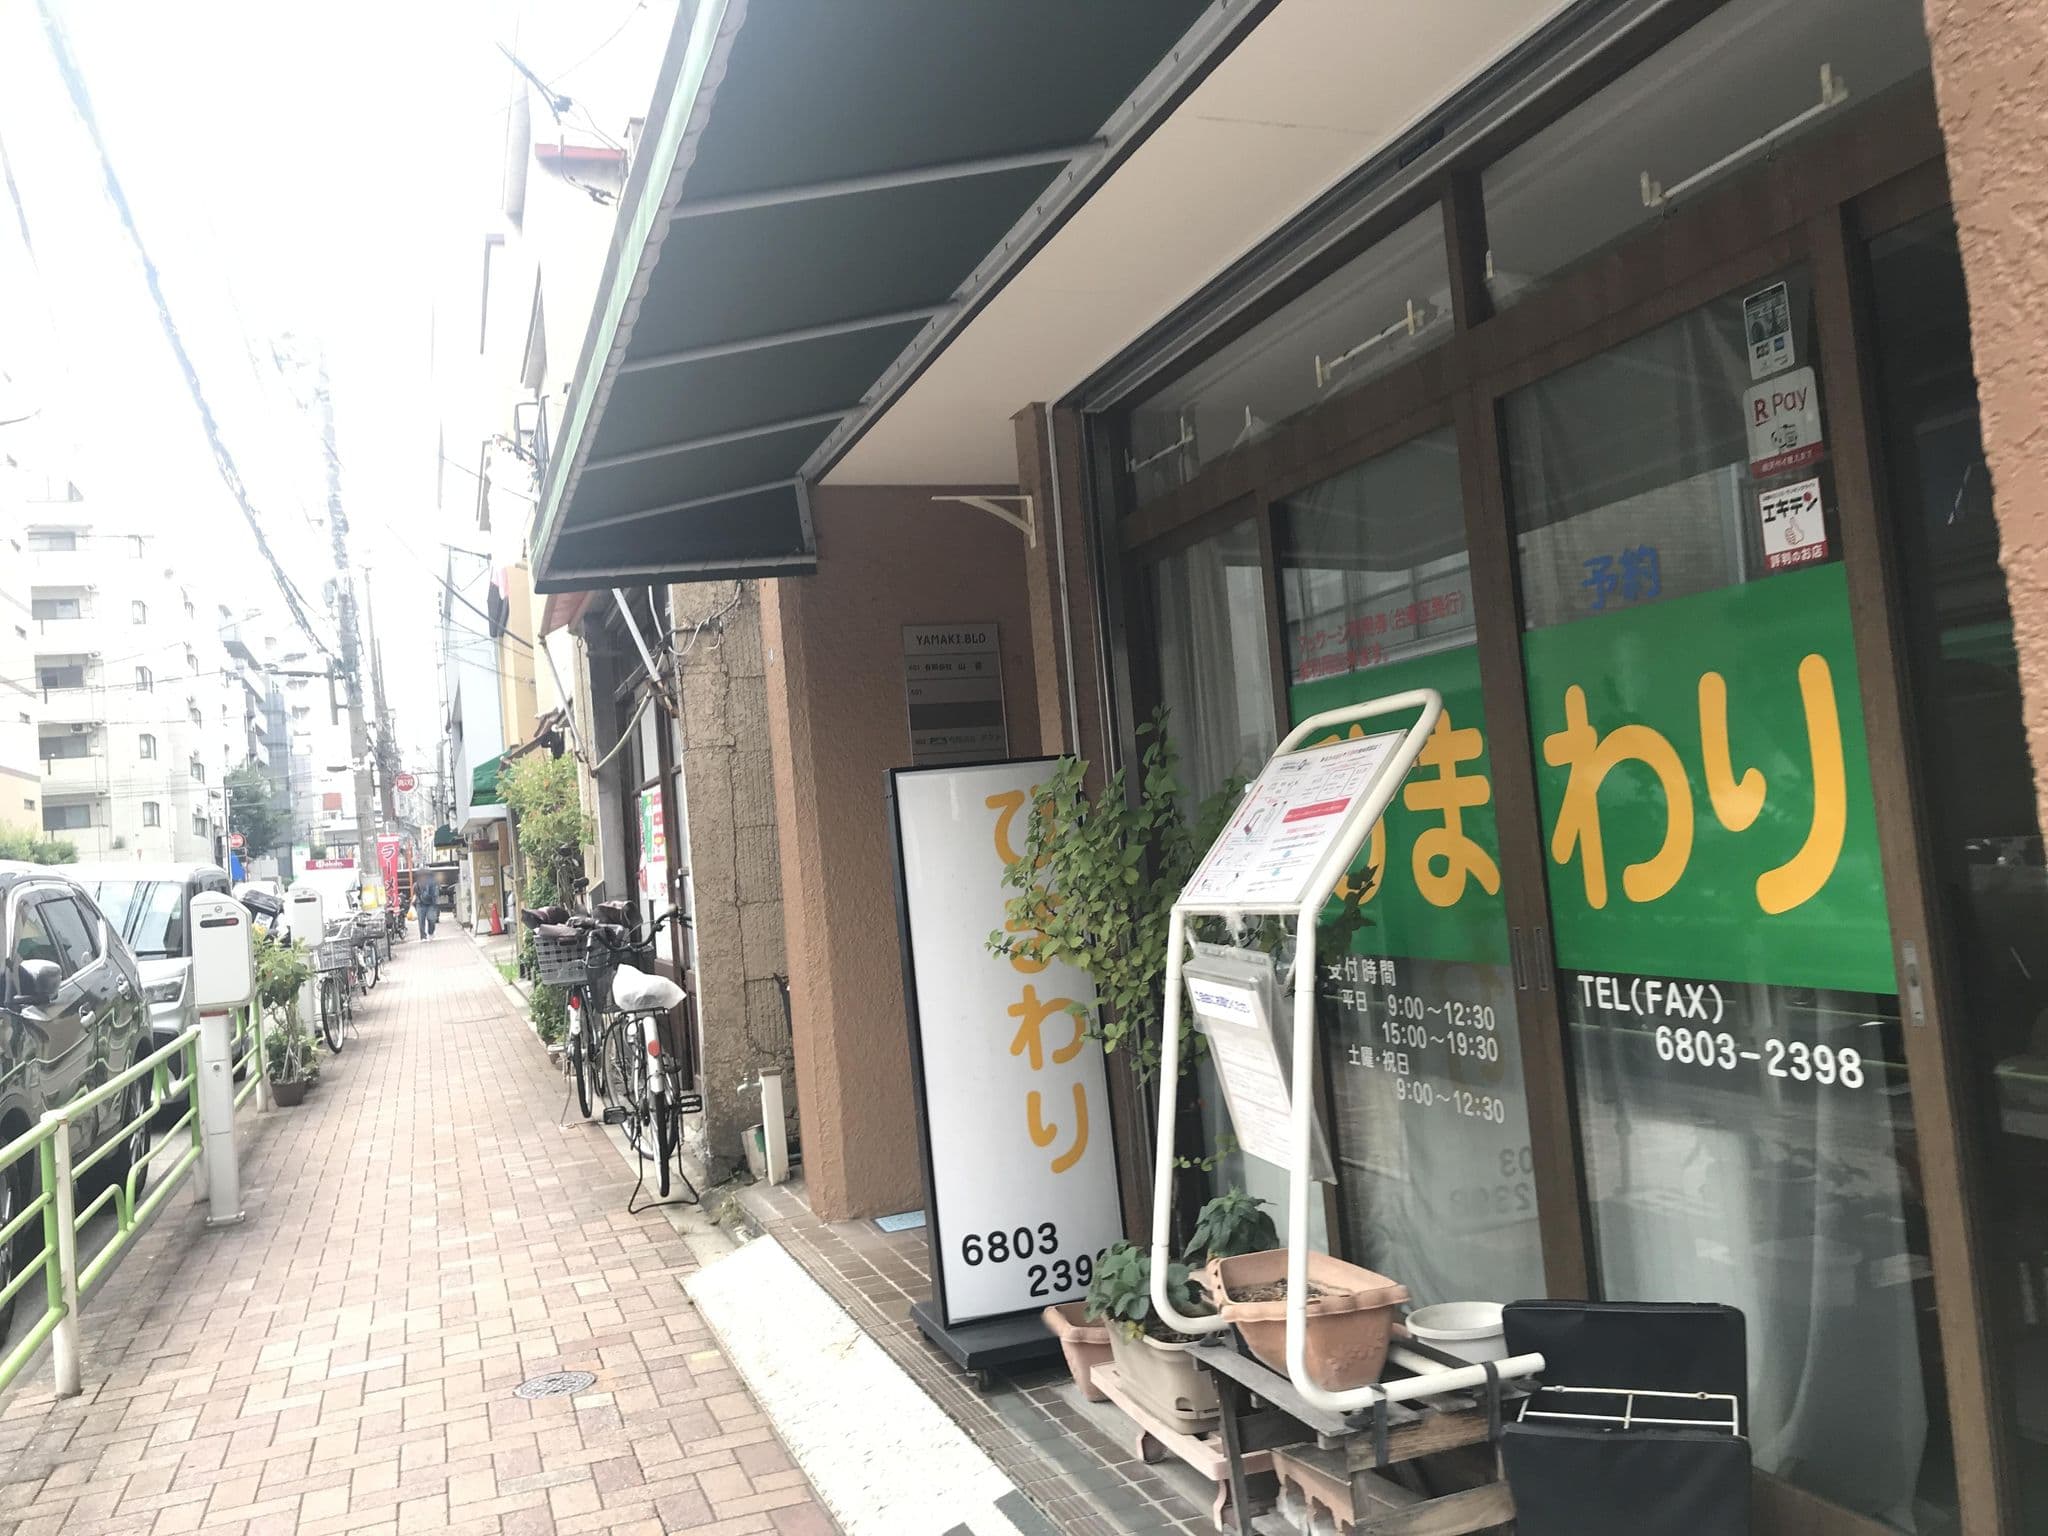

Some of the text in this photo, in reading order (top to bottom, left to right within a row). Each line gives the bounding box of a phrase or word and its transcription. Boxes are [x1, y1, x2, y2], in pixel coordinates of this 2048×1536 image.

[1772, 387, 1808, 417] Pay
[1762, 491, 1818, 523] エキテン
[1341, 989, 1367, 1011] 平日
[1577, 975, 1723, 1023] TEL(FAX)
[1656, 1026, 1864, 1089] 6803-2398
[961, 1222, 1059, 1267] 6803
[1027, 1248, 1107, 1298] 239
